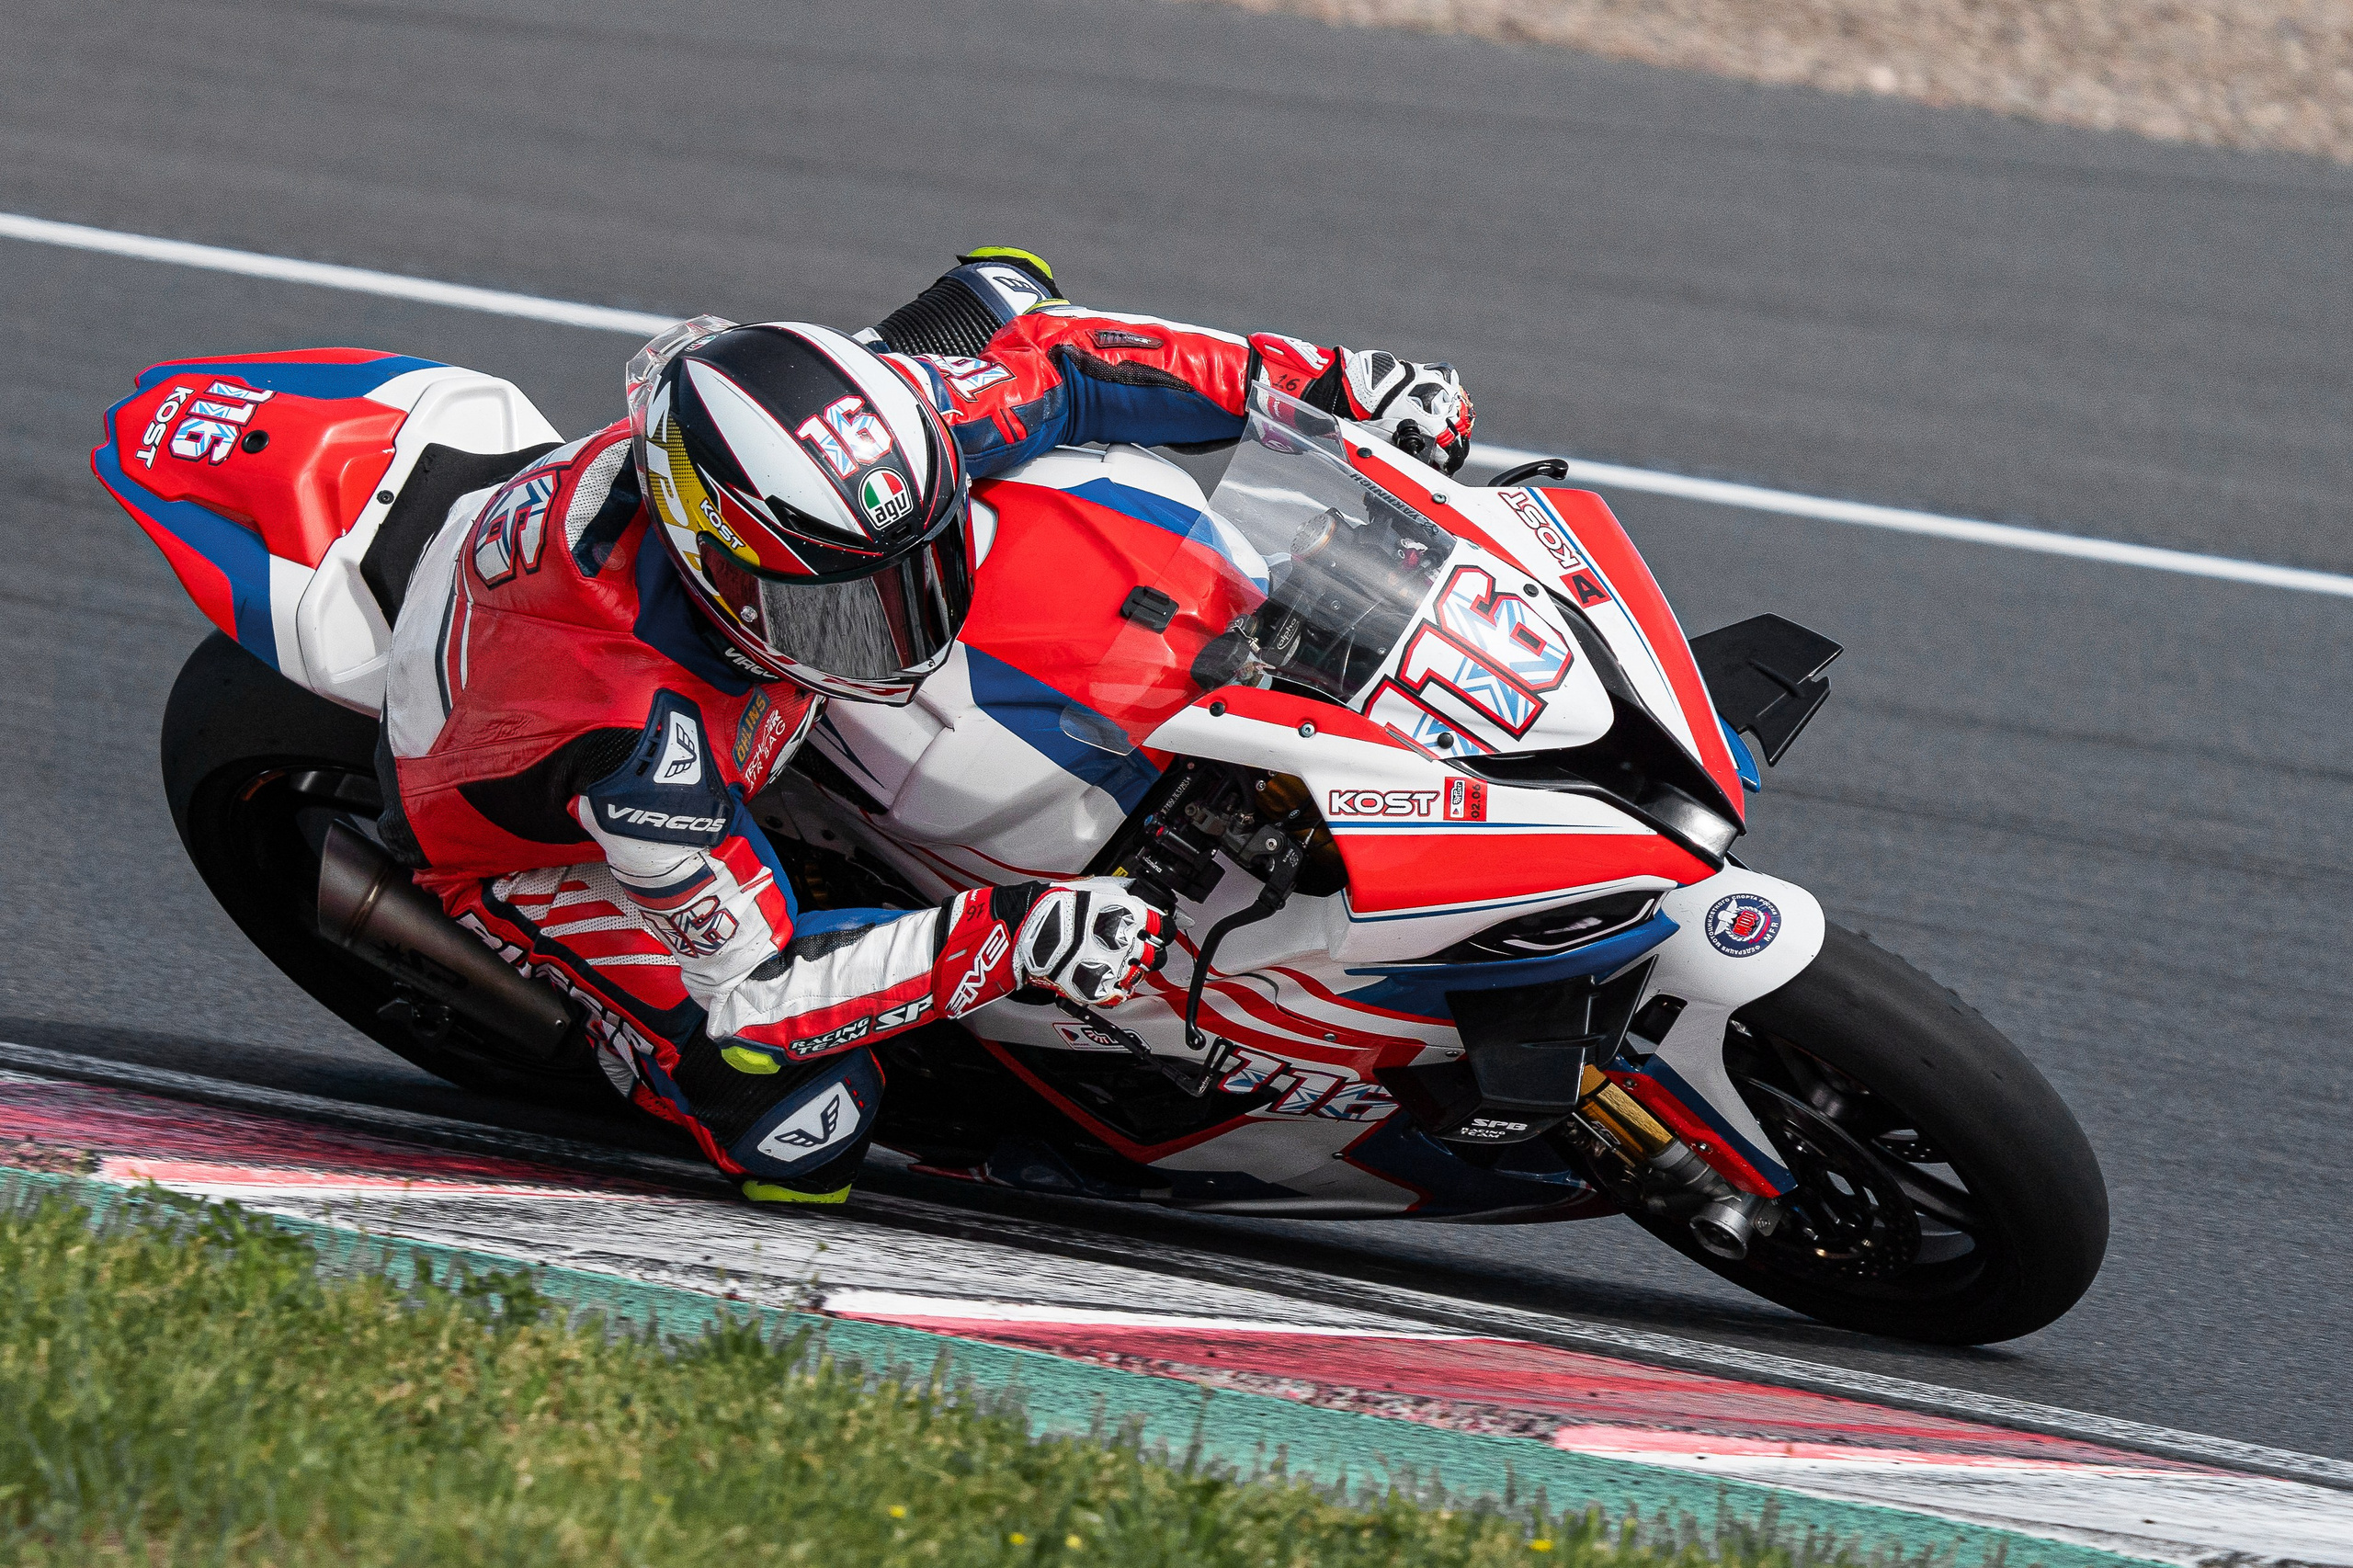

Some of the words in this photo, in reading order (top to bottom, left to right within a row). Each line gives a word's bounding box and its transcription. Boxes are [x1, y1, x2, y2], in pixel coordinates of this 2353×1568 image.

[1272, 373, 1301, 392] 16
[135, 385, 195, 470] KOST
[168, 379, 276, 466] 116
[794, 395, 893, 480] 16
[699, 498, 746, 550] KOST
[874, 493, 908, 525] agv
[1497, 491, 1581, 570] KOST
[1572, 574, 1607, 605] A
[1279, 618, 1297, 646] alpha
[1361, 564, 1574, 761] 116
[1329, 790, 1440, 817] KOST
[1471, 783, 1482, 819] 02.06
[607, 803, 727, 834] VIRGOS
[1763, 922, 1779, 942] MFR
[791, 1017, 870, 1050] RACING
[798, 1026, 868, 1055] TEAM
[1471, 1118, 1528, 1131] SPB
